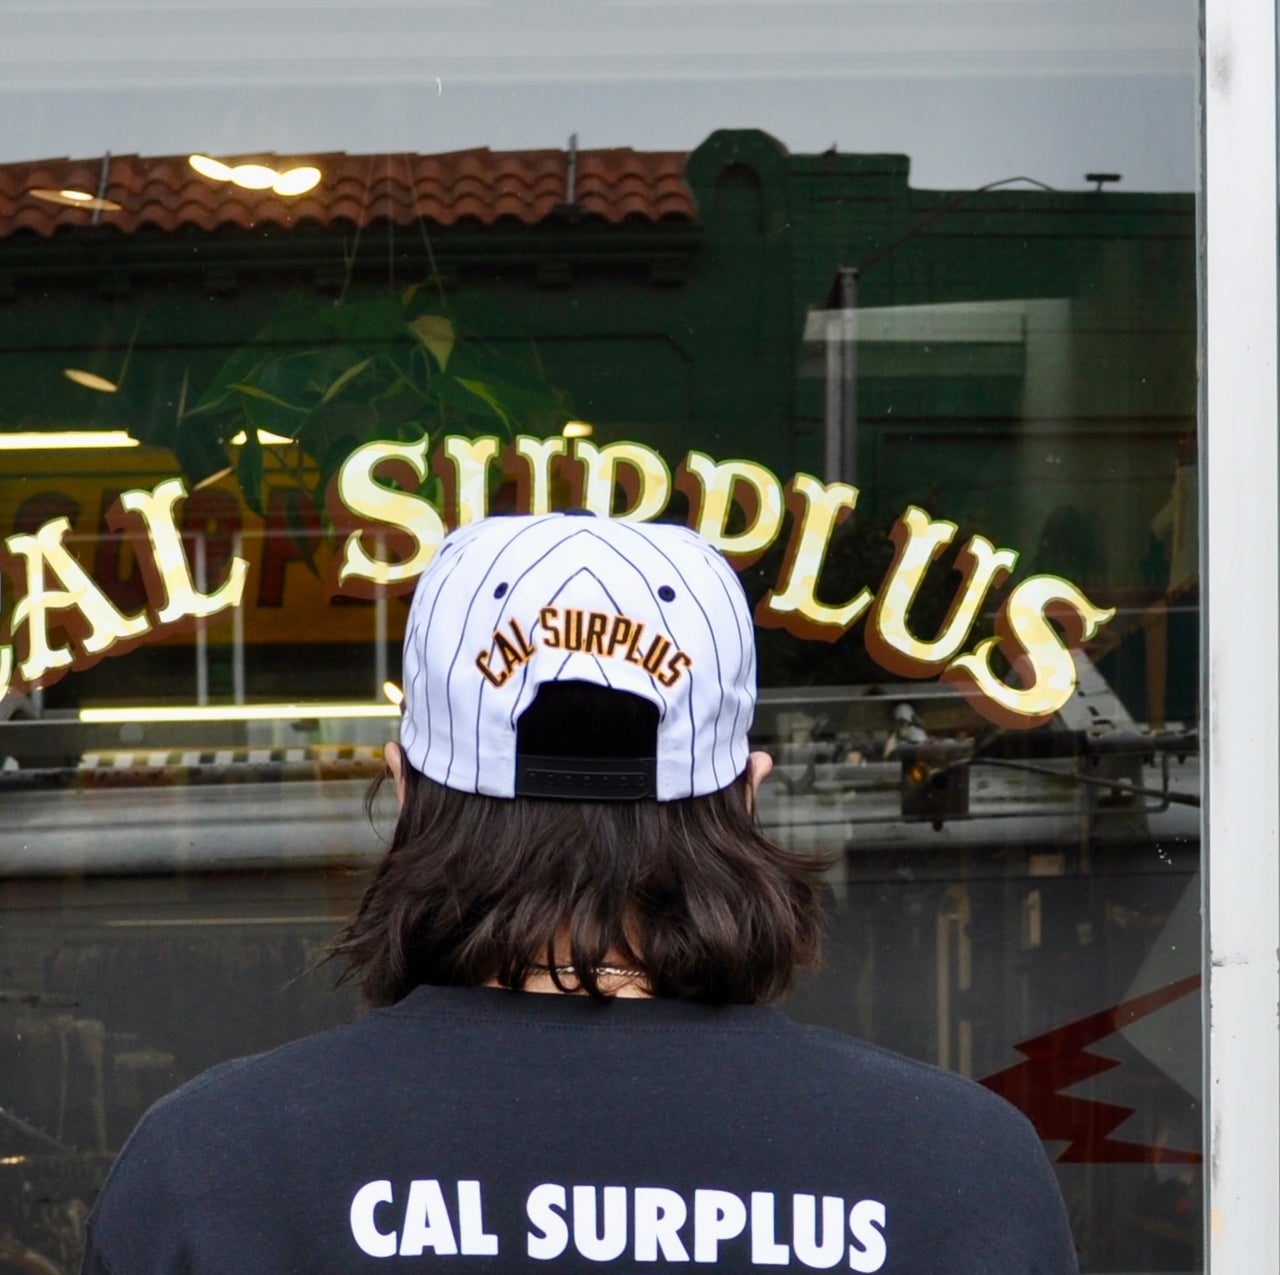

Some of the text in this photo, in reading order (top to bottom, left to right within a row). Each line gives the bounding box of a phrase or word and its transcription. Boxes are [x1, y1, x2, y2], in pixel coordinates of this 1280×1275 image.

[475, 605, 692, 690] CAL SURPLUS
[350, 1180, 888, 1273] CAL SURPLUS
